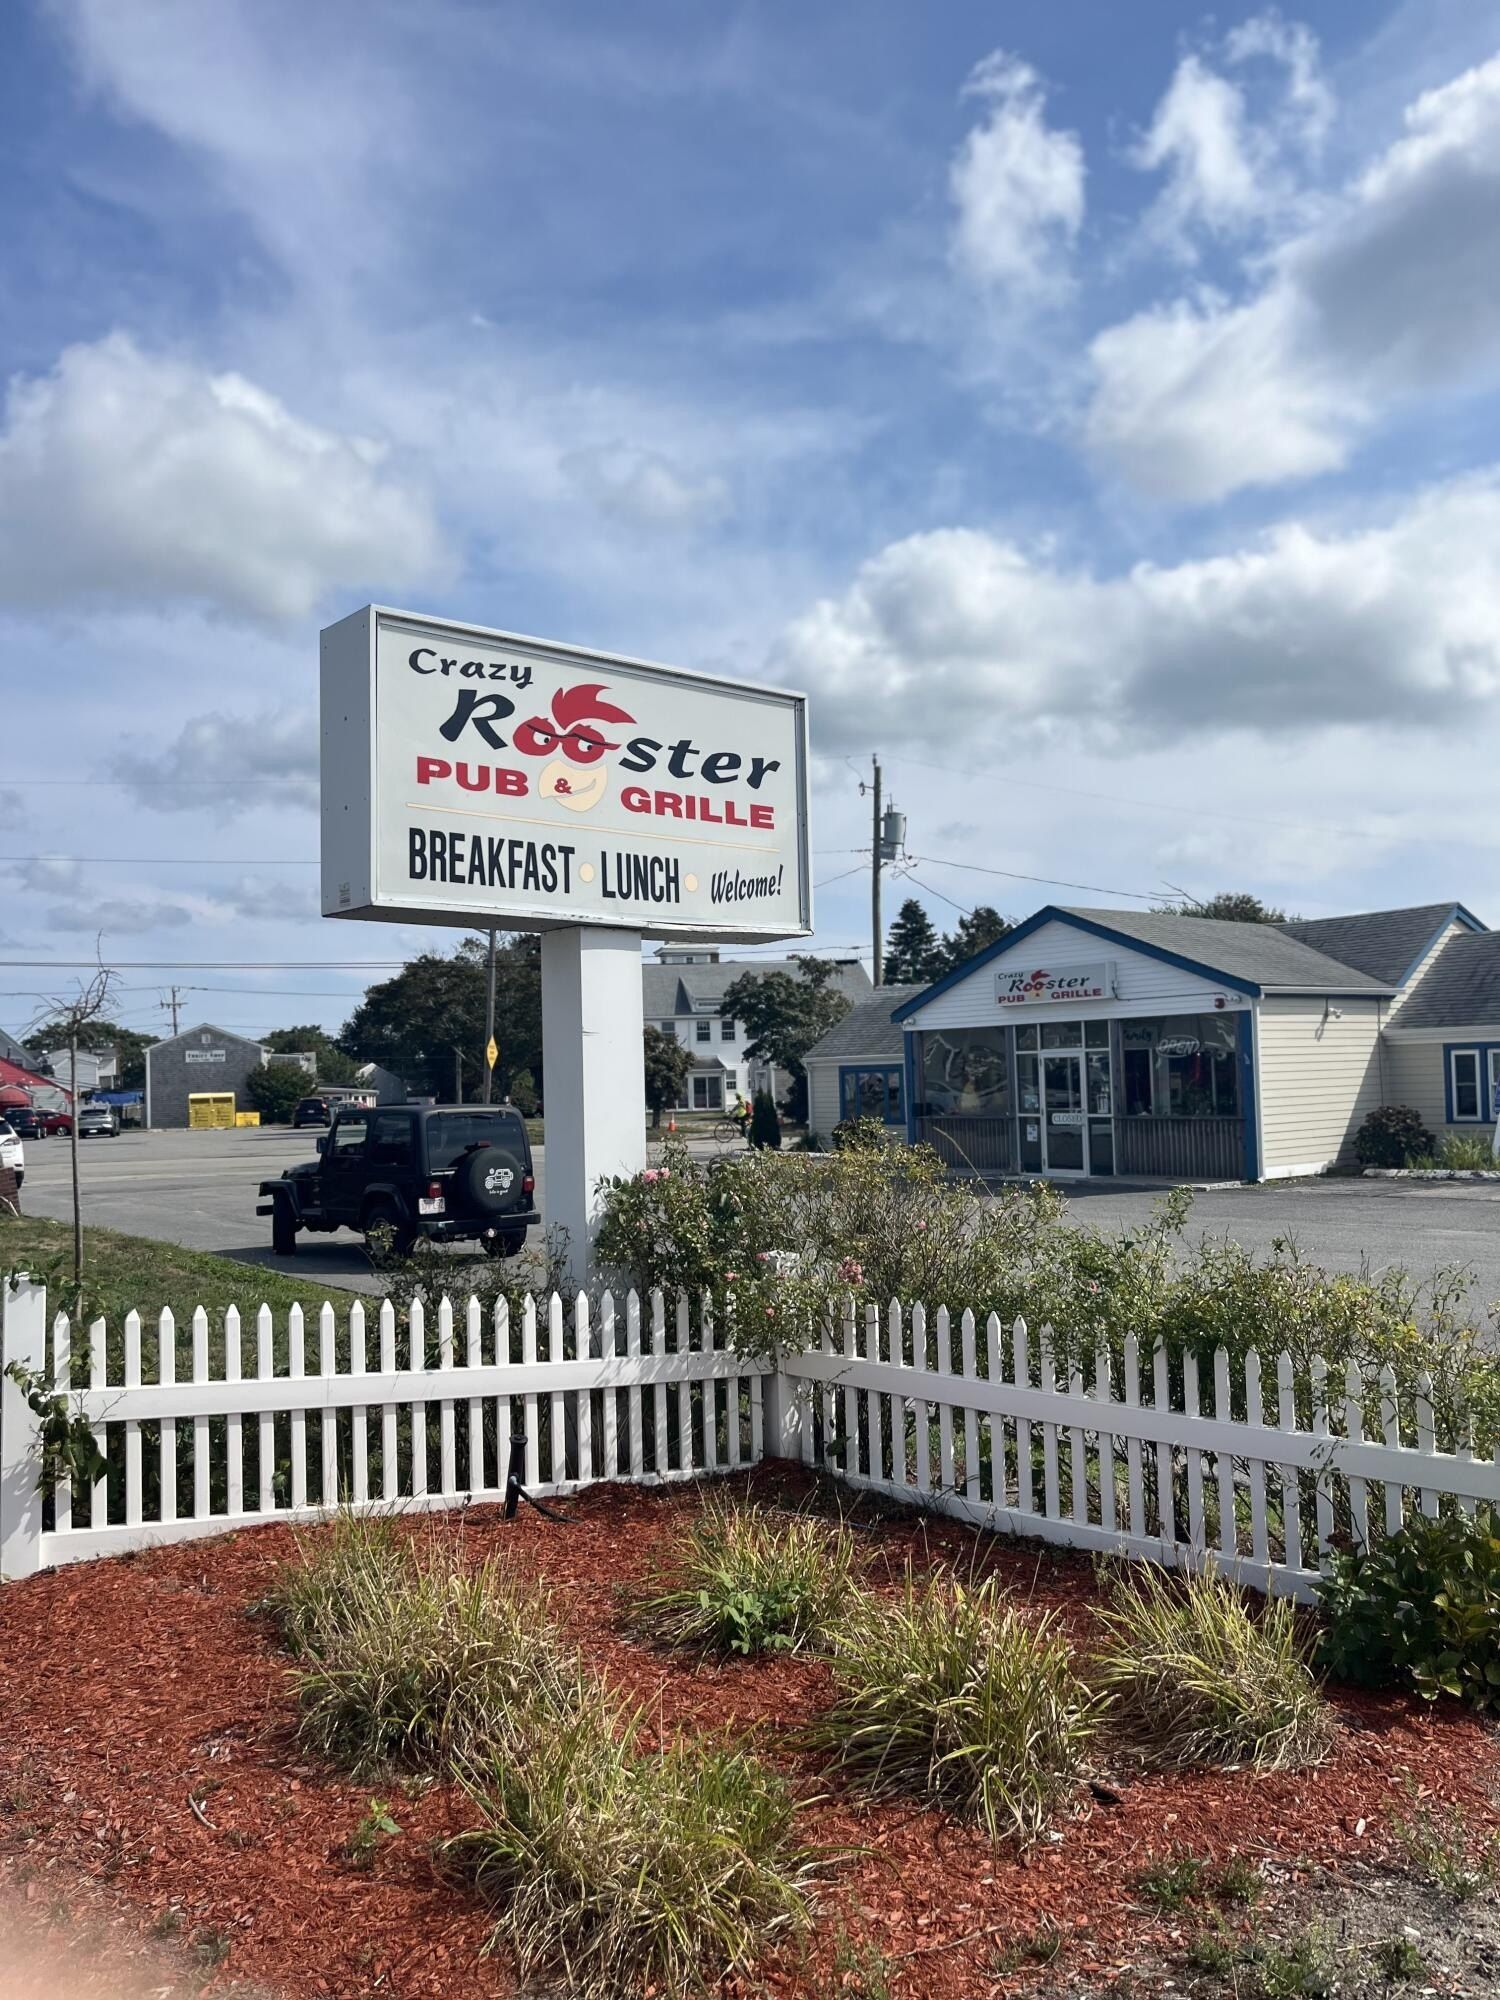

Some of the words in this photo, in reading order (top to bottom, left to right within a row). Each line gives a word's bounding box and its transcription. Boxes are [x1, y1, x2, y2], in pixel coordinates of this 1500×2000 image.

[408, 648, 533, 689] Crazy
[439, 689, 780, 789] Rooster
[416, 756, 529, 797] PUB
[554, 777, 573, 795] &
[620, 786, 775, 830] GRILLE
[408, 827, 576, 894] BREAKFAST
[601, 851, 680, 903] LUNCH
[711, 864, 784, 904] Welcome!
[998, 971, 1024, 980] Crazy
[1008, 976, 1090, 993] Rooster
[998, 994, 1025, 1004] PUB
[1051, 988, 1102, 1000] GRILLE
[1159, 1039, 1195, 1055] OPEN
[1053, 1114, 1084, 1123] CLOSED
